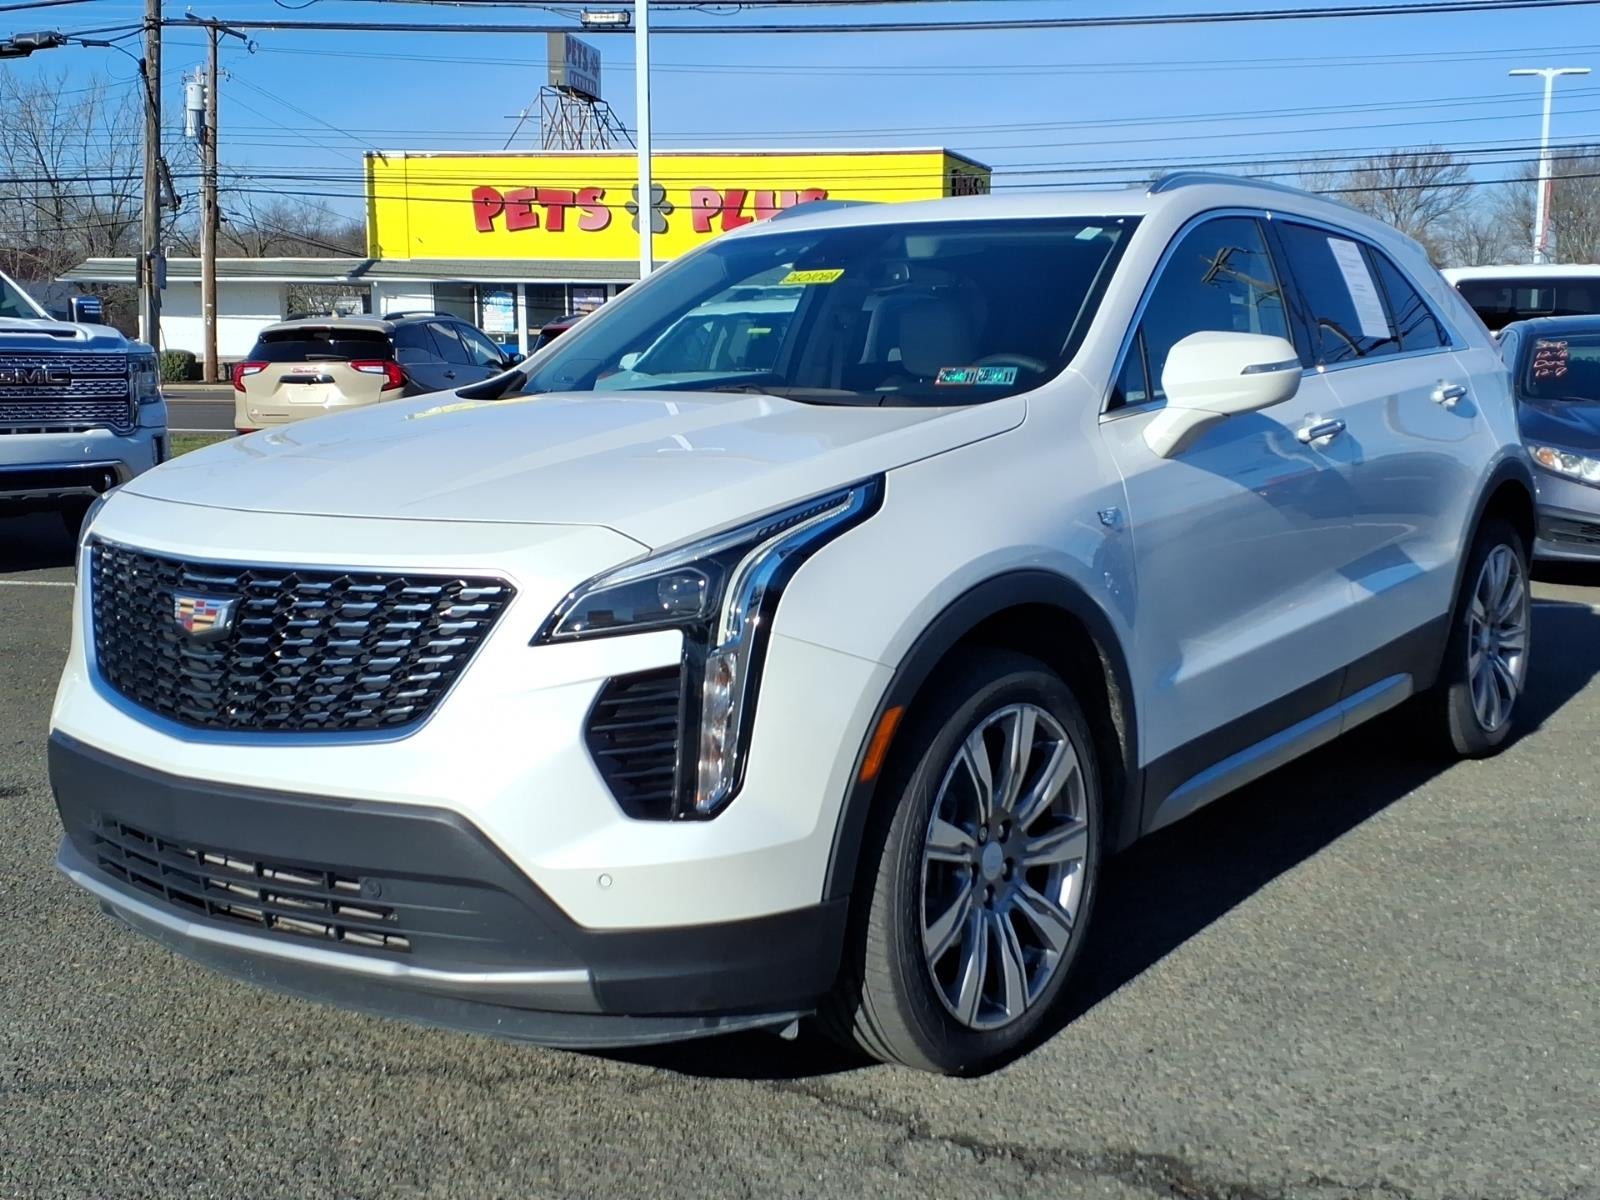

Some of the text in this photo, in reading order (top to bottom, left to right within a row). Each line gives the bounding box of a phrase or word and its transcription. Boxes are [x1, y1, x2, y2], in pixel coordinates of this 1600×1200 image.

[566, 36, 588, 72] PETS
[471, 186, 829, 232] PETS PLU
